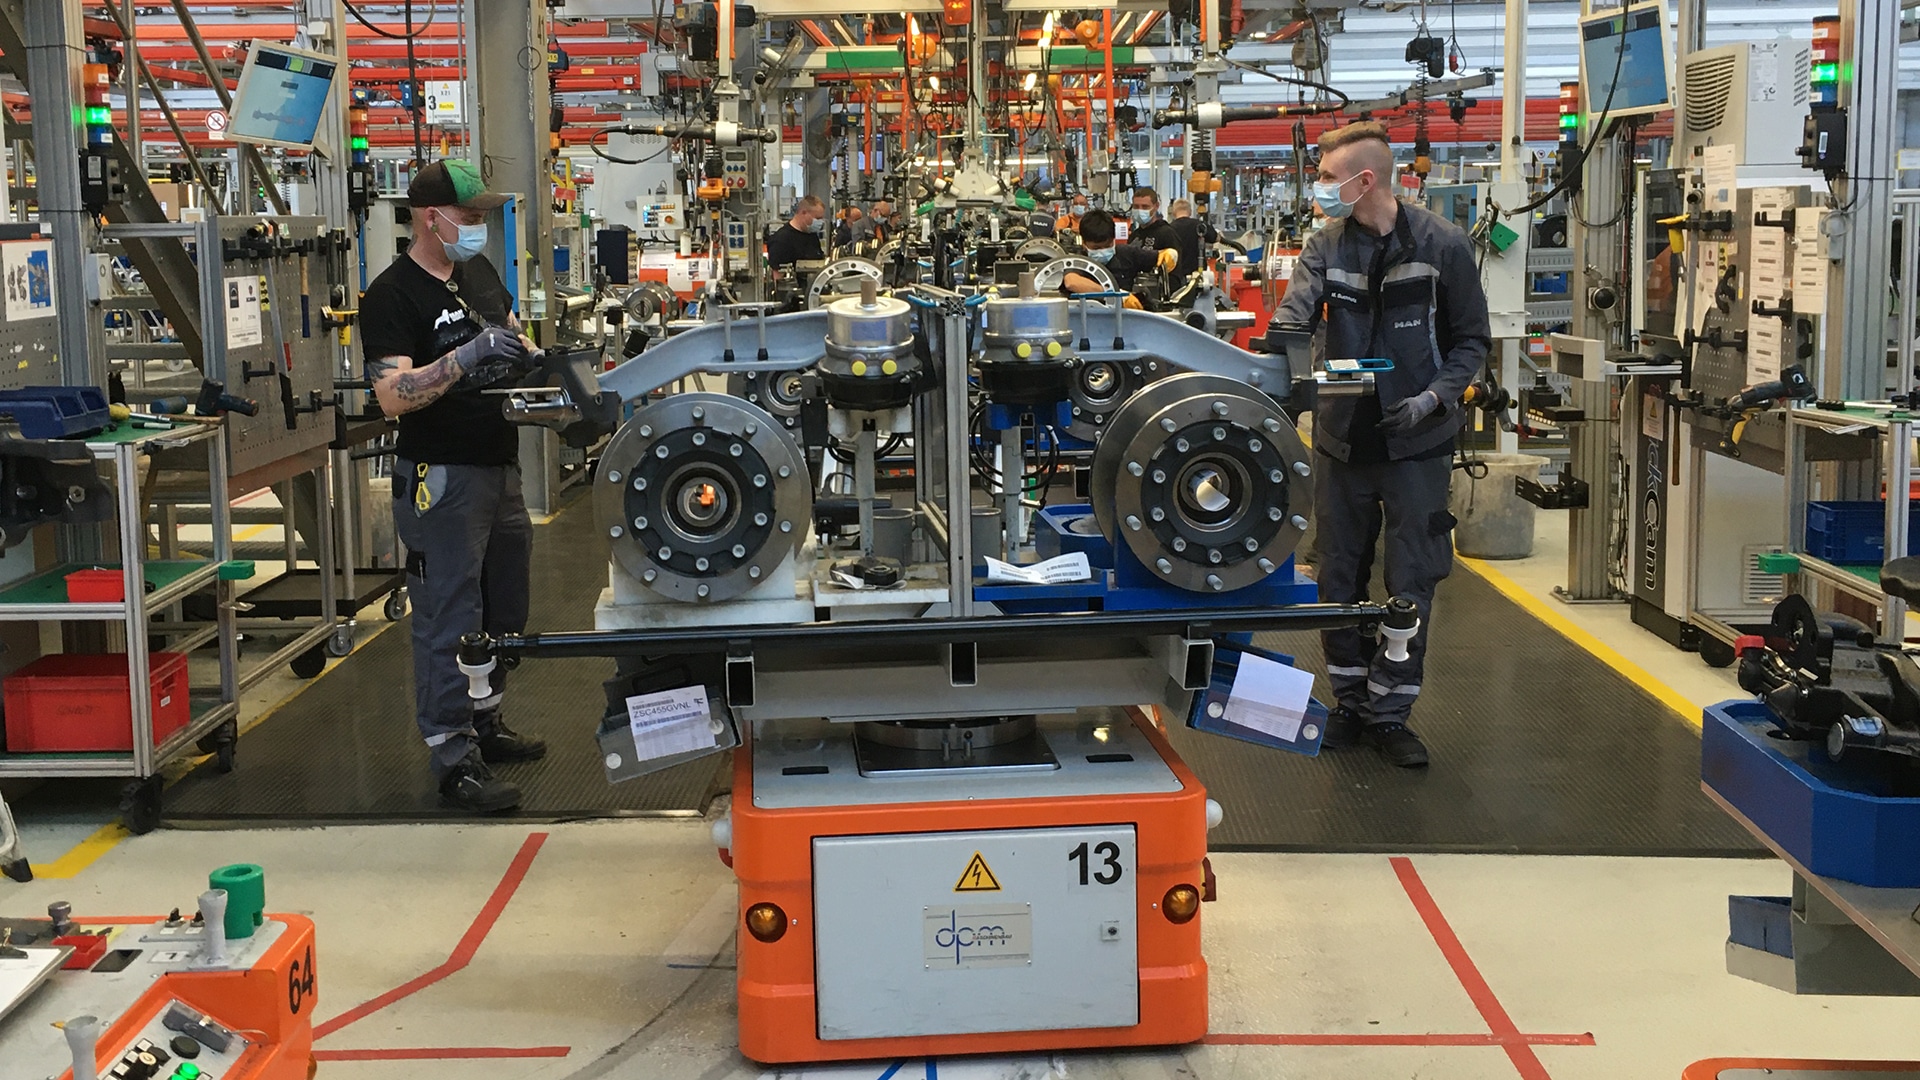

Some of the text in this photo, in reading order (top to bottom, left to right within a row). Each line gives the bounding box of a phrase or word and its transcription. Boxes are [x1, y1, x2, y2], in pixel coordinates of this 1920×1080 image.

[428, 95, 437, 110] 3
[1394, 319, 1422, 329] MAN
[633, 702, 691, 718] ZSC455GVNL
[1068, 841, 1123, 886] 13
[935, 909, 1005, 965] dpm
[288, 945, 314, 1015] 64
